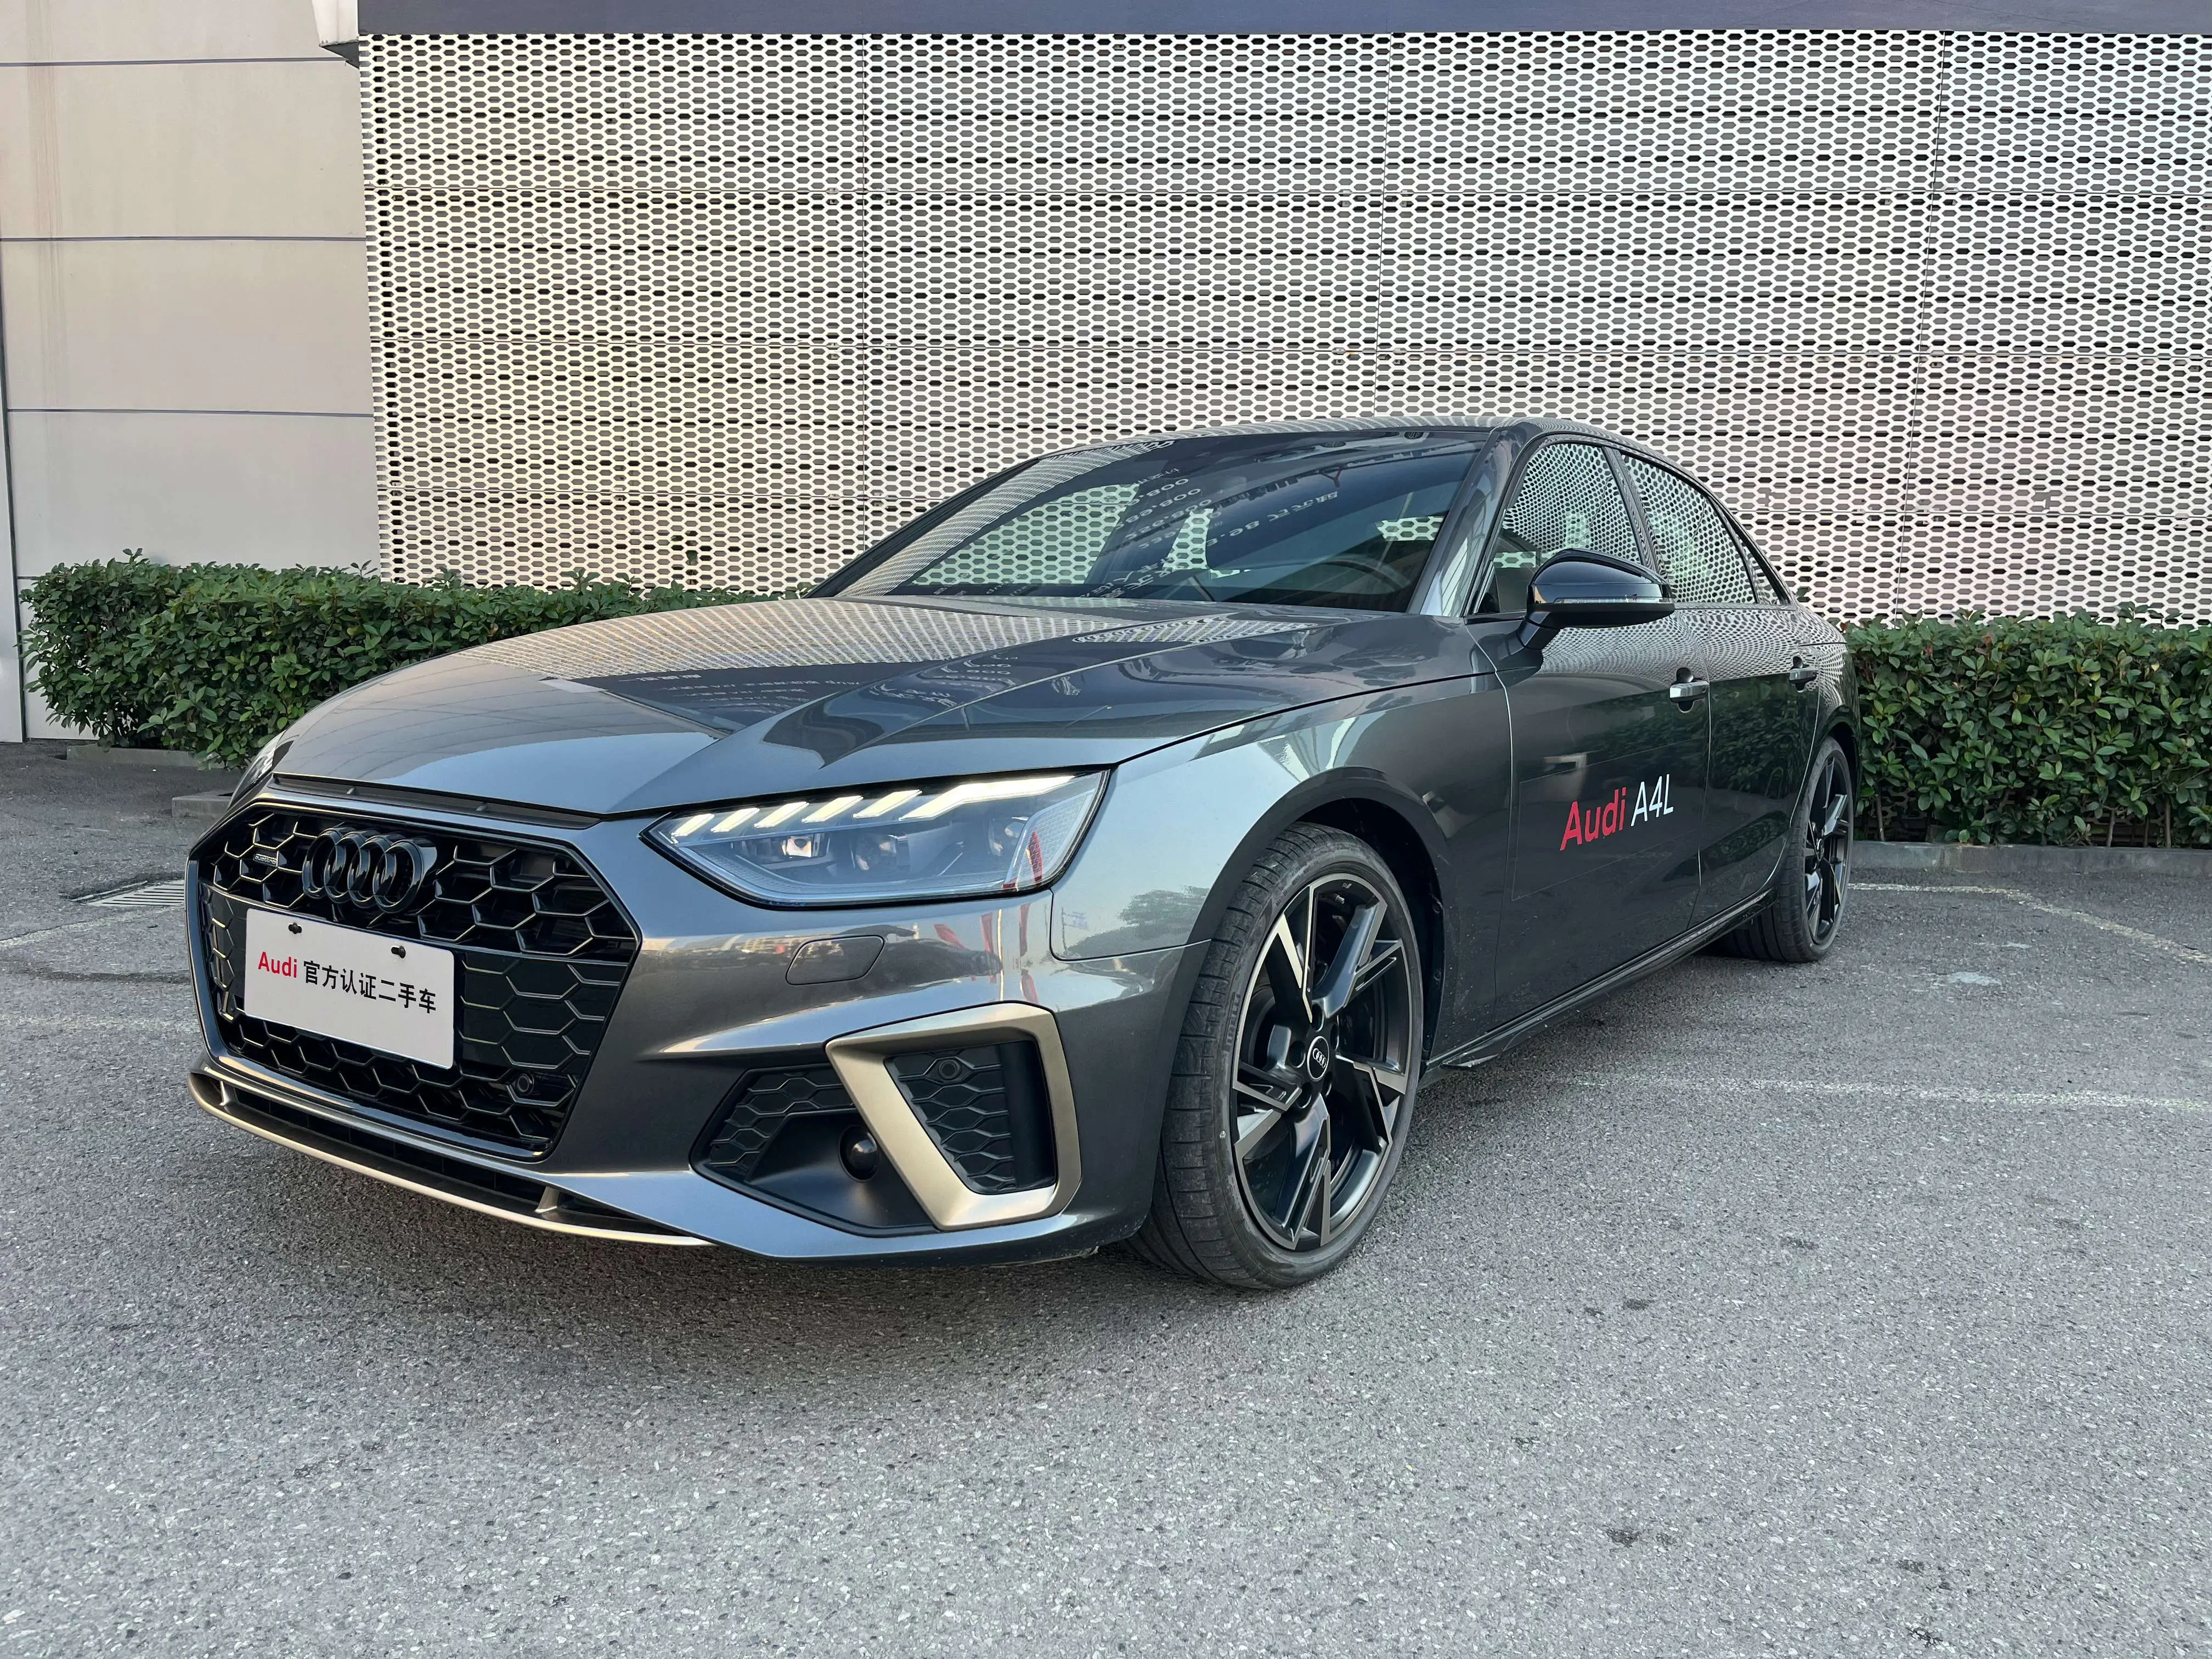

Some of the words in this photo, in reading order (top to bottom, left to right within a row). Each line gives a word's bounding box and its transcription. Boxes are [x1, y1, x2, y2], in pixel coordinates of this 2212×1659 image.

[1560, 787, 1627, 851] Audi
[1630, 774, 1674, 827] A4L
[258, 951, 298, 979] Audi
[303, 960, 437, 1014] 官方认证二手车
